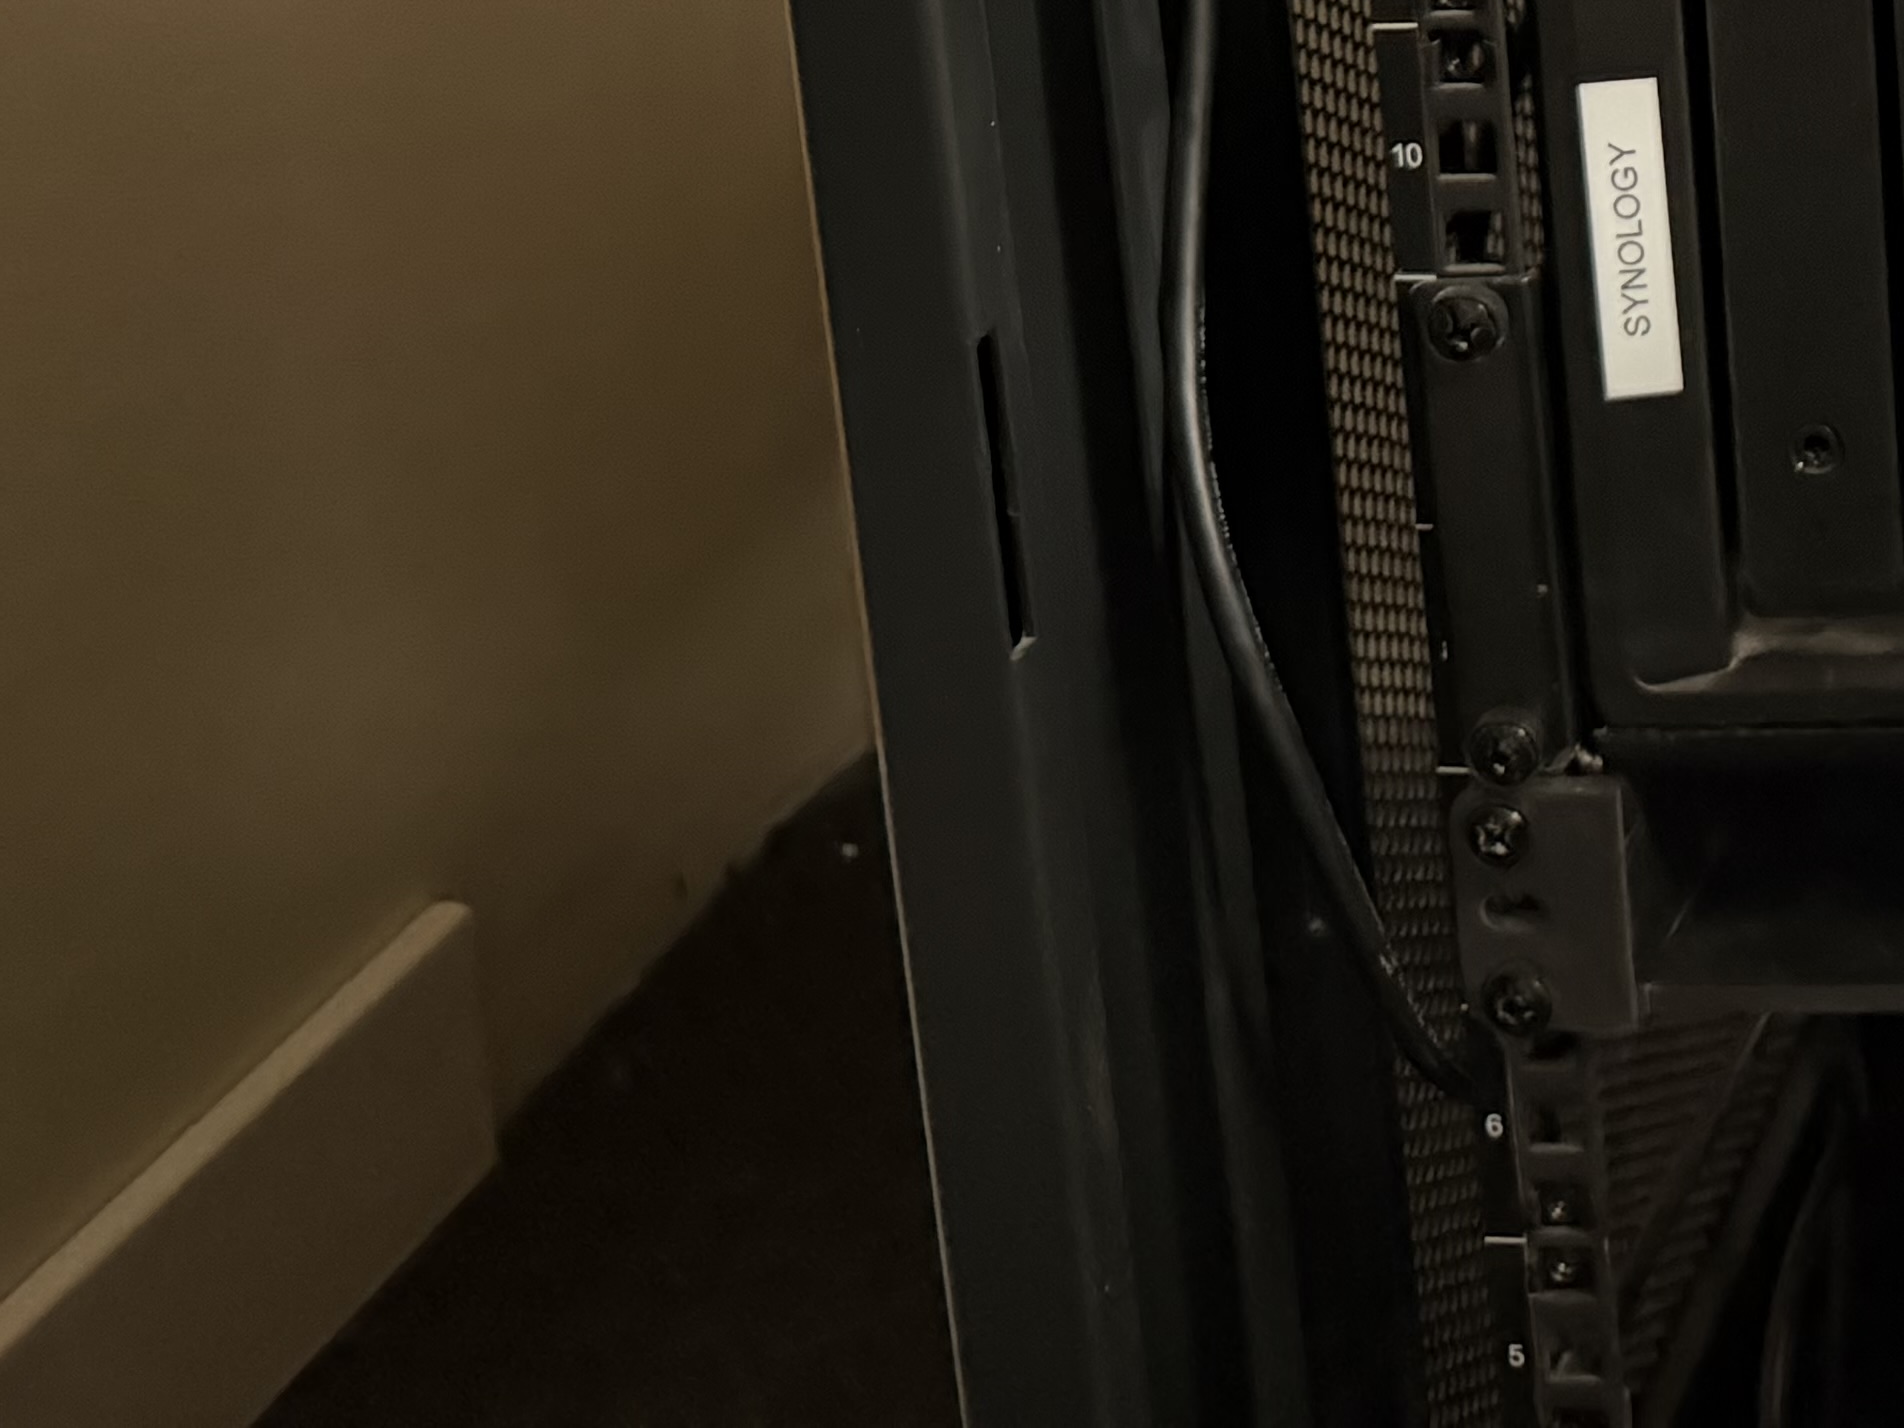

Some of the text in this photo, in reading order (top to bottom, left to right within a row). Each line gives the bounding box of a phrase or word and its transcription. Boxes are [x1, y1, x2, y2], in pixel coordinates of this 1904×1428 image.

[1392, 144, 1422, 168] 10
[1607, 142, 1653, 338] SYNOLOGY
[1486, 1113, 1503, 1138] 6
[1508, 1344, 1525, 1367] 5
